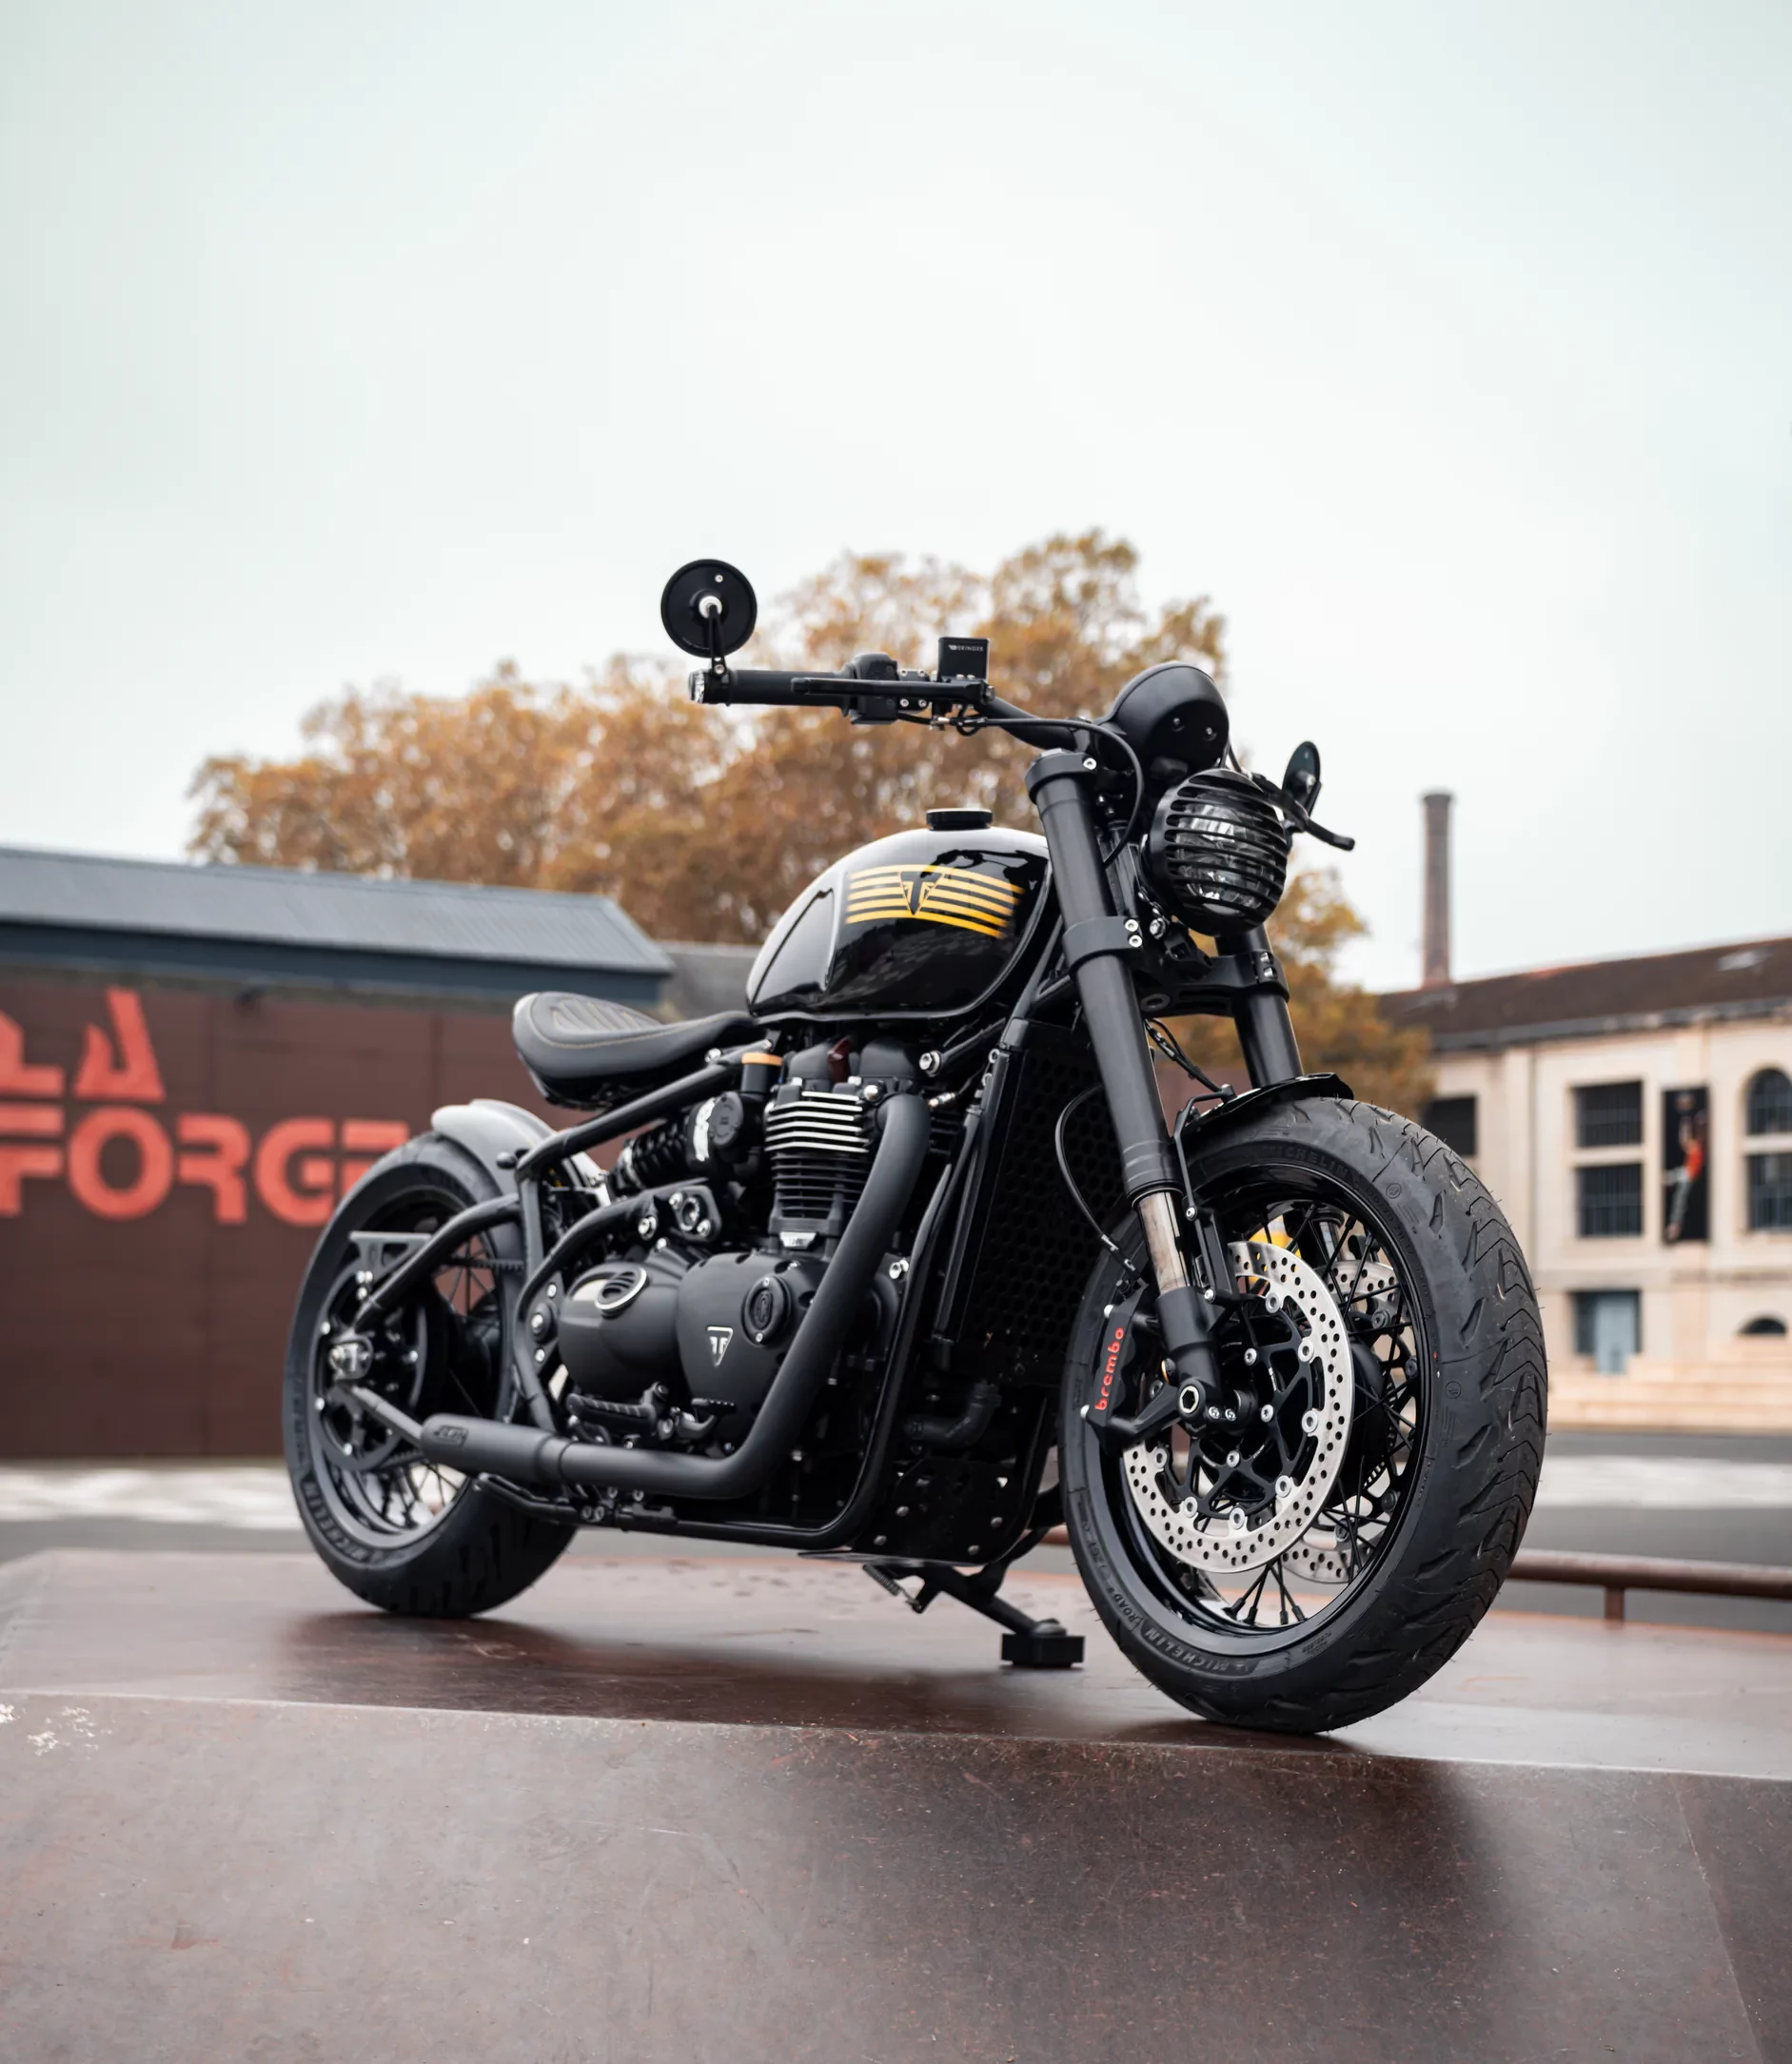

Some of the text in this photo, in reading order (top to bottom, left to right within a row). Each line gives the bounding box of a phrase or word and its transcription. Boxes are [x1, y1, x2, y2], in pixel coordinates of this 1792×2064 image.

[0, 987, 165, 1102] LA
[1094, 1327, 1124, 1410] brembo
[1113, 1593, 1142, 1626] ROAD
[1145, 1627, 1230, 1671] MICHELIN
